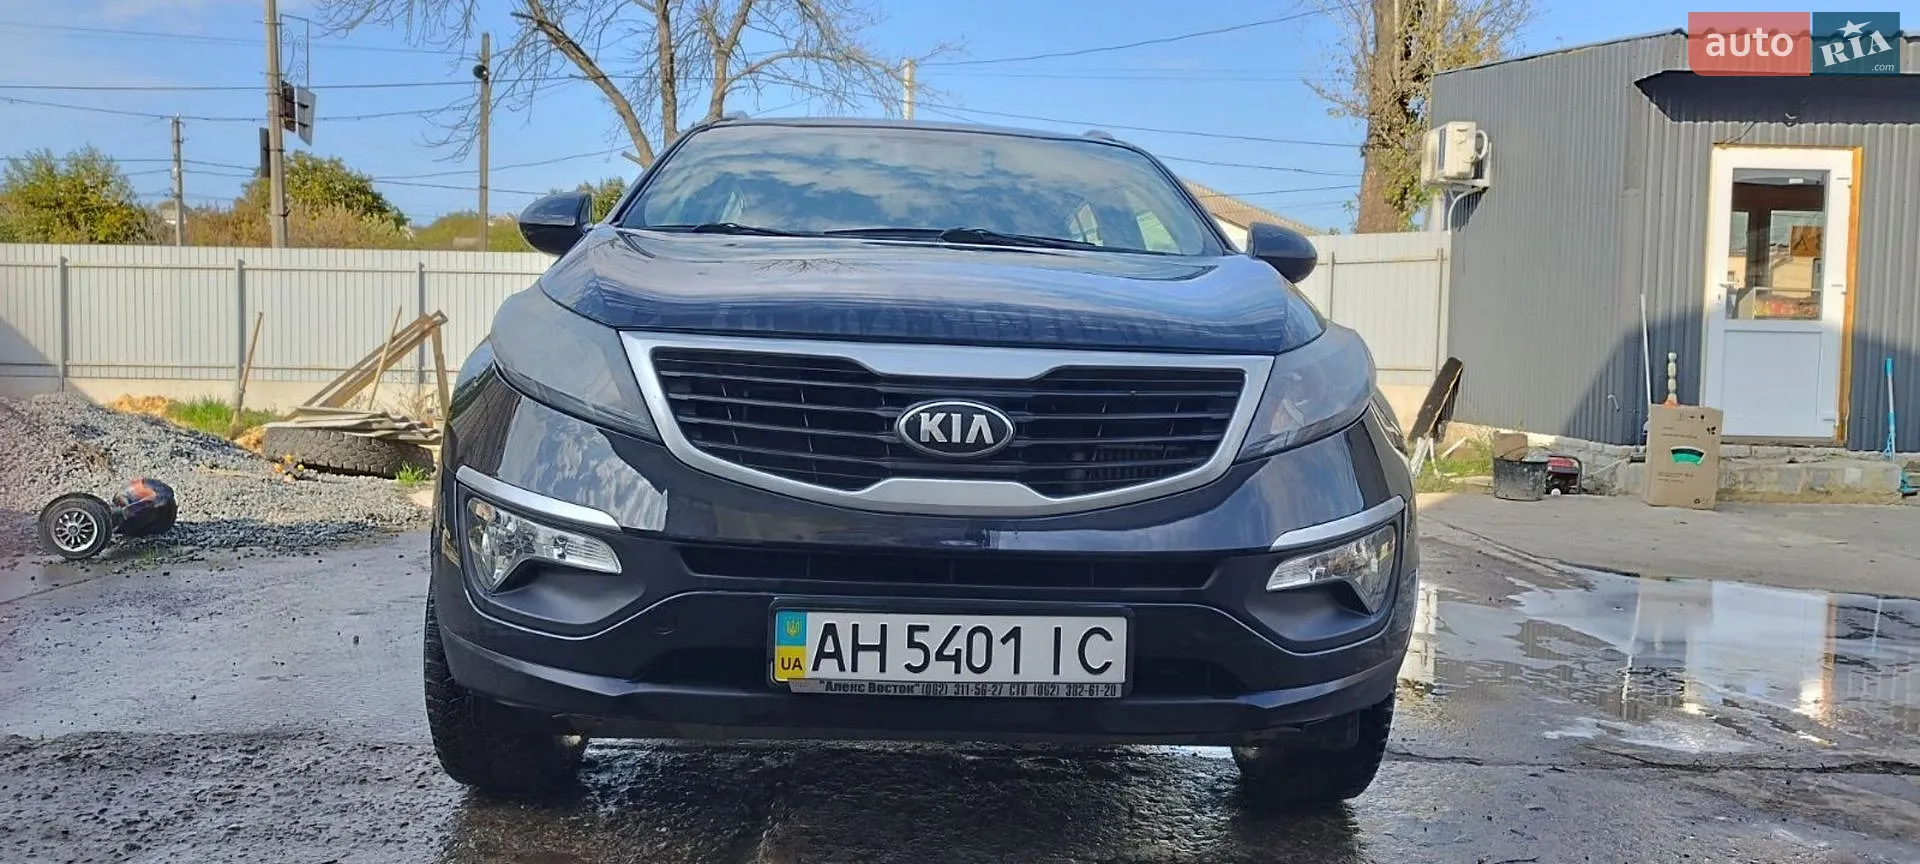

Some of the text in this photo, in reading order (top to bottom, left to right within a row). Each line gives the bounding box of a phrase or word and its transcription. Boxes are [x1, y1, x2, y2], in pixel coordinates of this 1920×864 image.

[919, 412, 994, 444] KIA
[780, 657, 803, 671] UA
[811, 622, 888, 673] AH
[904, 625, 1022, 675] 5401
